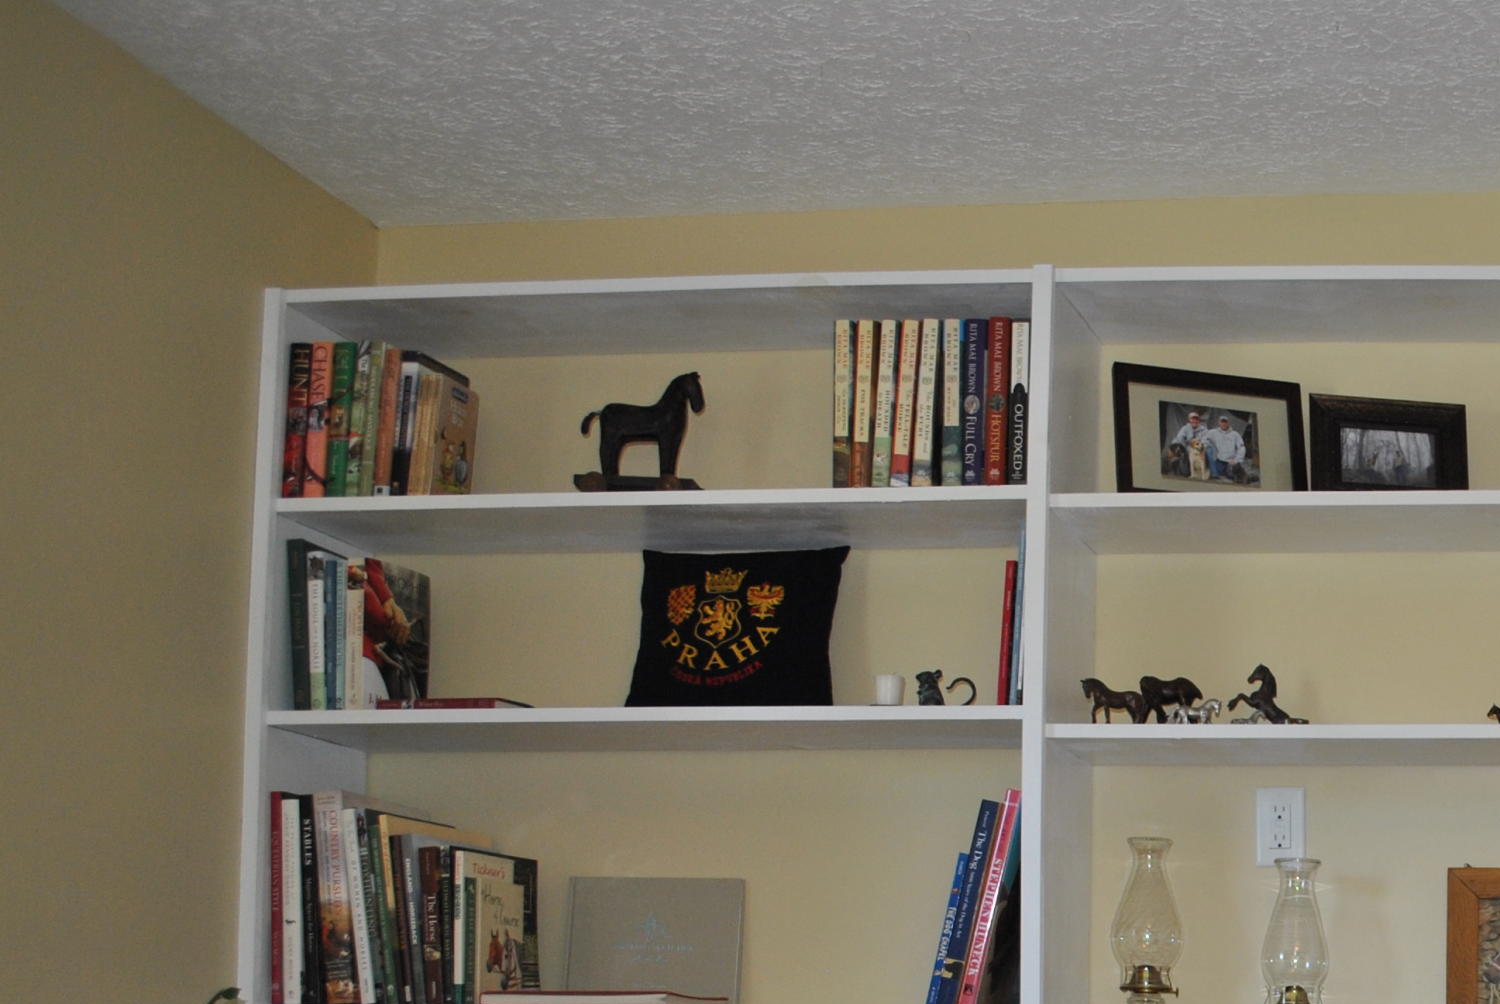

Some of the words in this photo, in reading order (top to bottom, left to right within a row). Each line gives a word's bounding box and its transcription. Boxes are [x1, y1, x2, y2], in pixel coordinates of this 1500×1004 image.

[970, 323, 978, 344] RITA
[994, 321, 1004, 341] RITA
[969, 344, 977, 361] MAE
[994, 342, 1003, 360] MAE
[294, 349, 310, 403] HUNT
[311, 345, 328, 402] CHASE
[967, 363, 976, 394] BROWN
[993, 362, 1002, 393] BROWN
[965, 416, 978, 441] FULL
[990, 414, 1002, 463] HOTSPUR
[1012, 403, 1025, 471] OUTFOXED
[964, 443, 977, 467] CRY
[311, 642, 321, 670] HORSE
[660, 628, 780, 671] PRAHA
[303, 818, 313, 867] STABLES
[329, 809, 341, 861] COUNTRY
[975, 829, 989, 849] The
[405, 858, 414, 893] ENGLAND
[968, 850, 984, 871] Dog
[331, 864, 342, 915] PURSUITS
[427, 893, 438, 914] The
[981, 857, 1005, 919] STEPHEN
[408, 901, 419, 945] HORSEBACK
[427, 915, 438, 943] Horse
[967, 919, 993, 977] HUNECK
